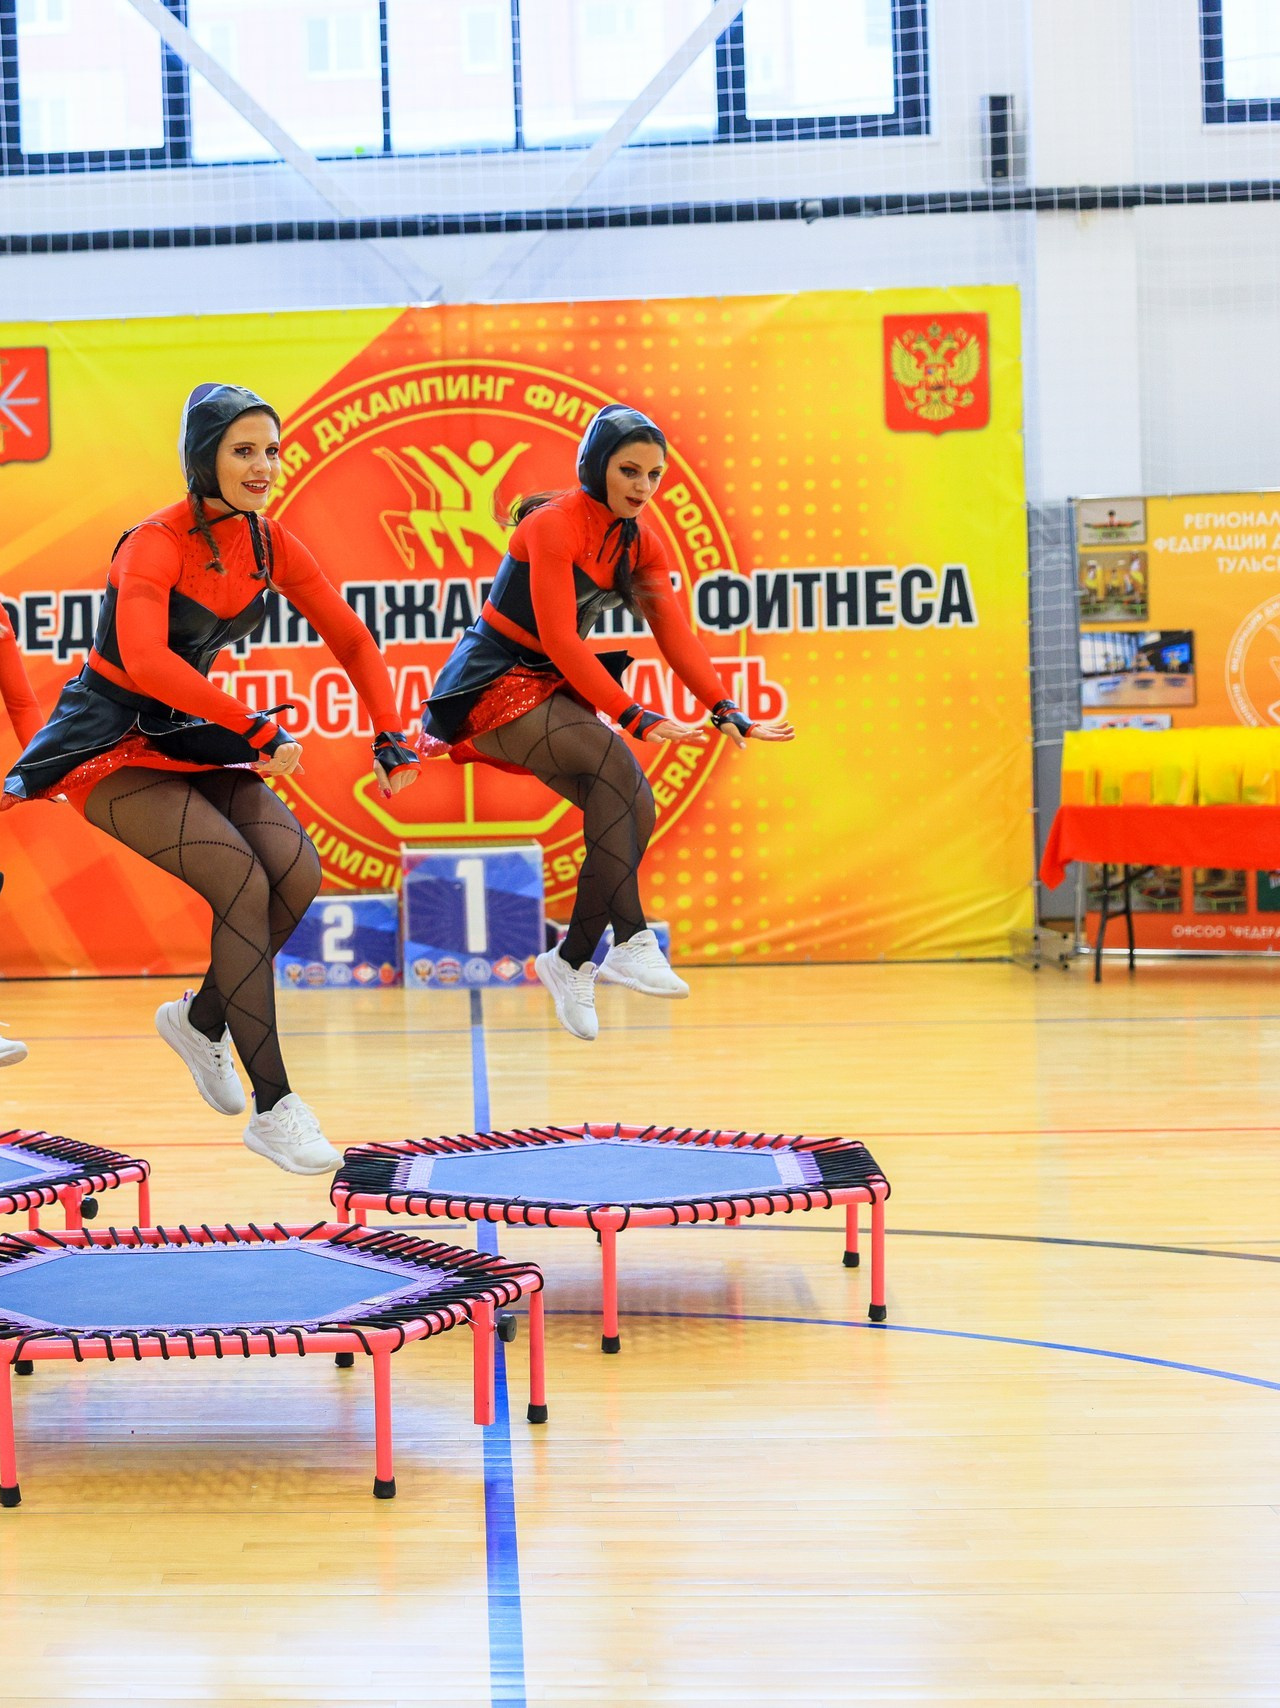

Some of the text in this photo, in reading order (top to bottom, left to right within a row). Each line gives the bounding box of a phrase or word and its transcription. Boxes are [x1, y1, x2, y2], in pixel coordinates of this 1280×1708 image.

[312, 375, 515, 452] ДЖАМПИНГ
[663, 482, 722, 576] РОСС
[1153, 533, 1267, 554] ФЕДЕРАЦИИ
[1217, 554, 1280, 574] ТУЛЬС
[696, 566, 976, 632] ФИТНЕСА
[322, 904, 355, 963] 2
[455, 859, 488, 953] 1
